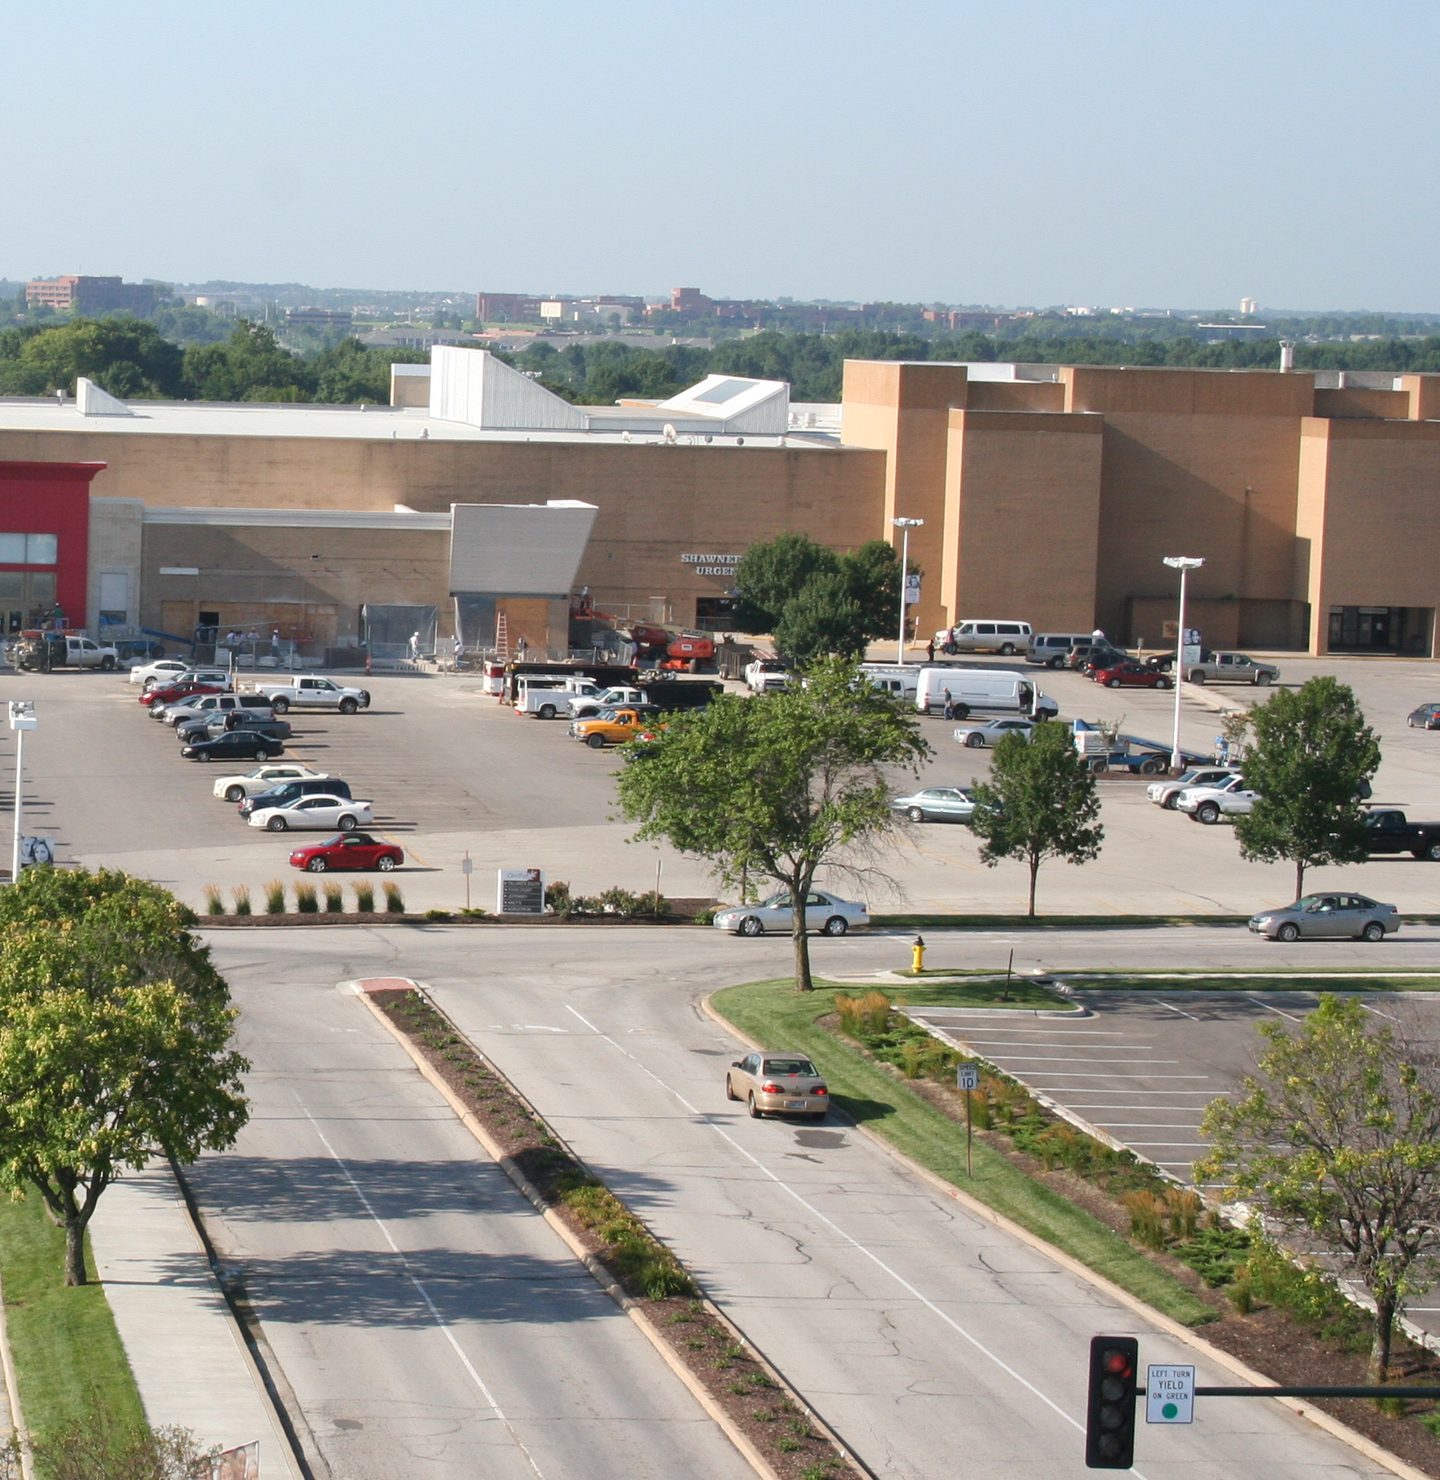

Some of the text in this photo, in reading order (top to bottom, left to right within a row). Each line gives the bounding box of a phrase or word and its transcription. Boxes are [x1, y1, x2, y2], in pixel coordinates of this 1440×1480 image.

[962, 1077, 974, 1088] 10
[1151, 1370, 1191, 1378] LEFT TURN
[1158, 1380, 1184, 1390] YIELD
[1166, 1392, 1188, 1400] GREEN
